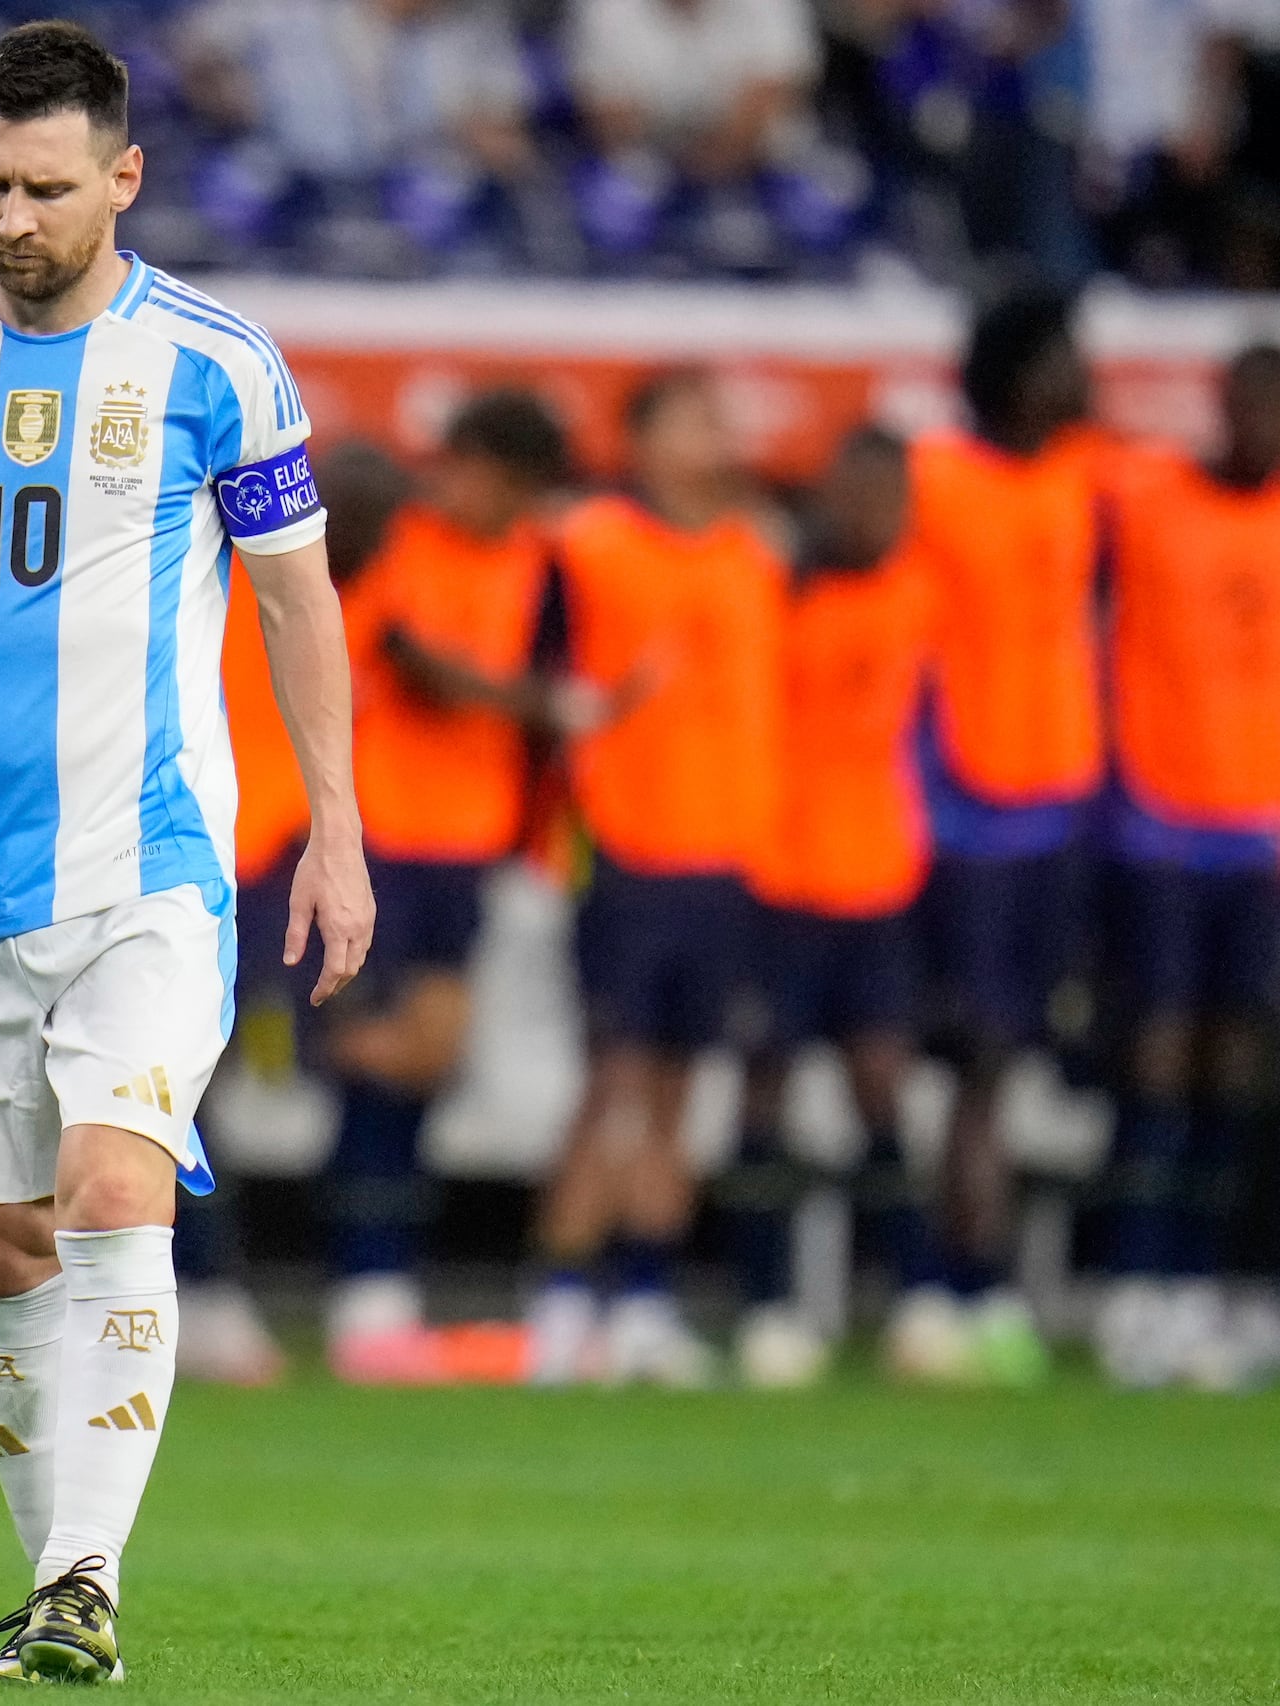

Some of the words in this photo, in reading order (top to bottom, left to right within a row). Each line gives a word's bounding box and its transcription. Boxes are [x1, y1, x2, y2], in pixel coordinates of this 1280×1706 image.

[101, 417, 136, 450] AFA
[273, 454, 311, 491] ELIGE
[279, 478, 319, 518] INCLU
[97, 1309, 166, 1352] AFA
